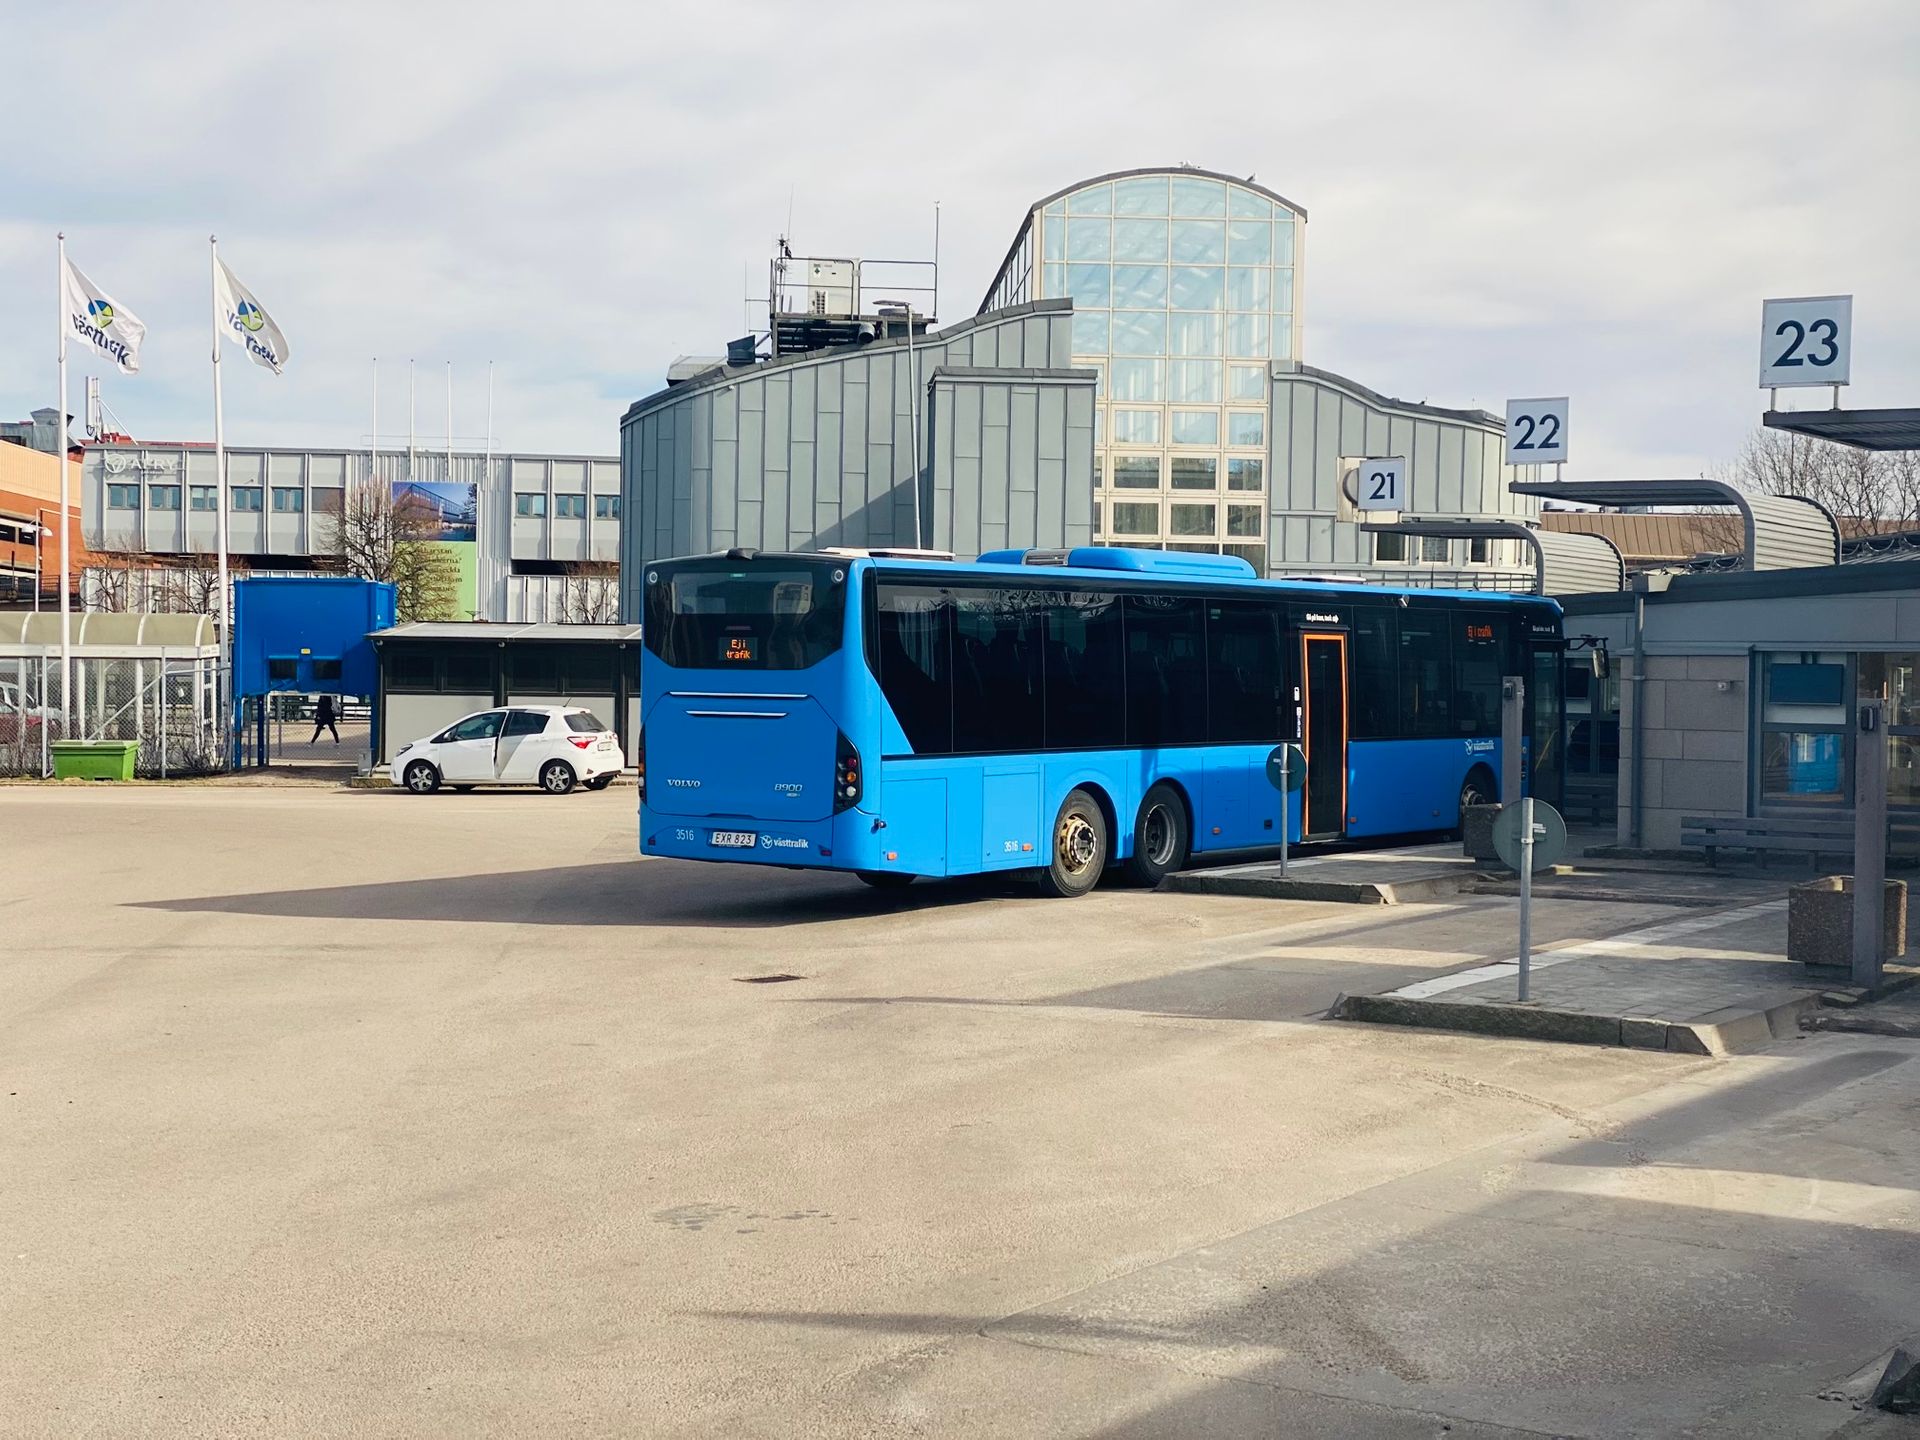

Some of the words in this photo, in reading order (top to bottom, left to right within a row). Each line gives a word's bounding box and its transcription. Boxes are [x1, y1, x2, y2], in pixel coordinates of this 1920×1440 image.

[1772, 318, 1839, 367] 23
[1513, 413, 1560, 450] 22
[1369, 472, 1395, 500] 21
[731, 639, 741, 649] Ej
[726, 650, 751, 659] trafik
[667, 779, 701, 787] VOLVO
[774, 783, 803, 791] 8900
[676, 829, 694, 841] 3516
[715, 833, 732, 844] EXR
[734, 834, 752, 845] 823
[773, 838, 809, 849] västtrafik
